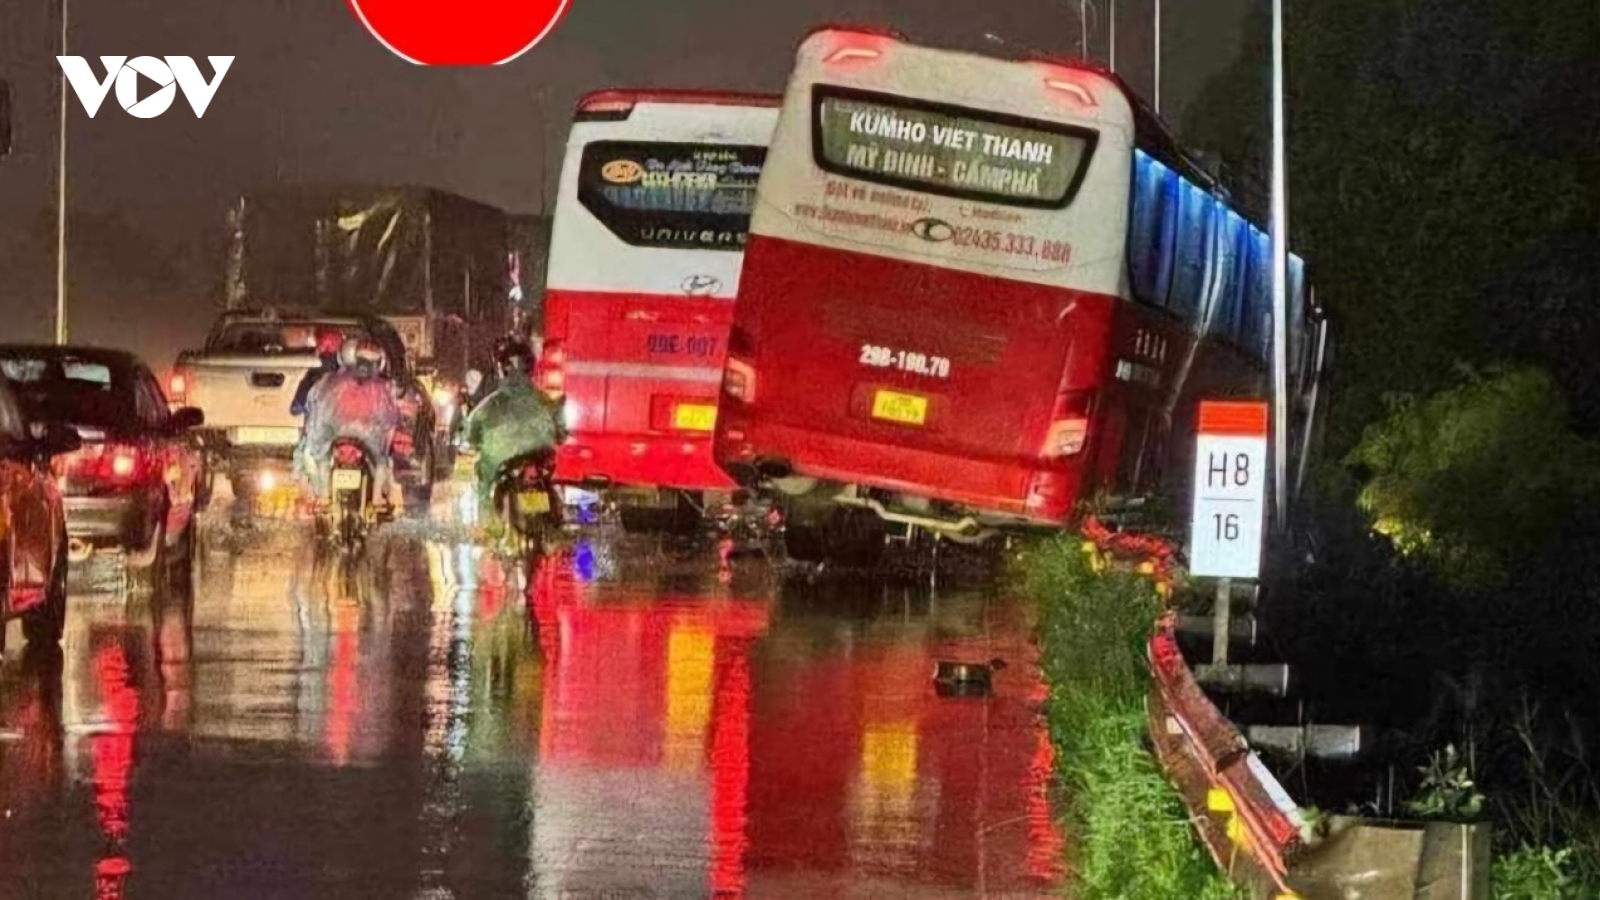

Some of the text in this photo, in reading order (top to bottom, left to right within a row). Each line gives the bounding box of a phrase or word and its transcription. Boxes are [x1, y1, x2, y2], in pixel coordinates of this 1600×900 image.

[850, 111, 926, 142] KUMHO
[982, 134, 1053, 164] THANH
[1213, 513, 1239, 542] 16
